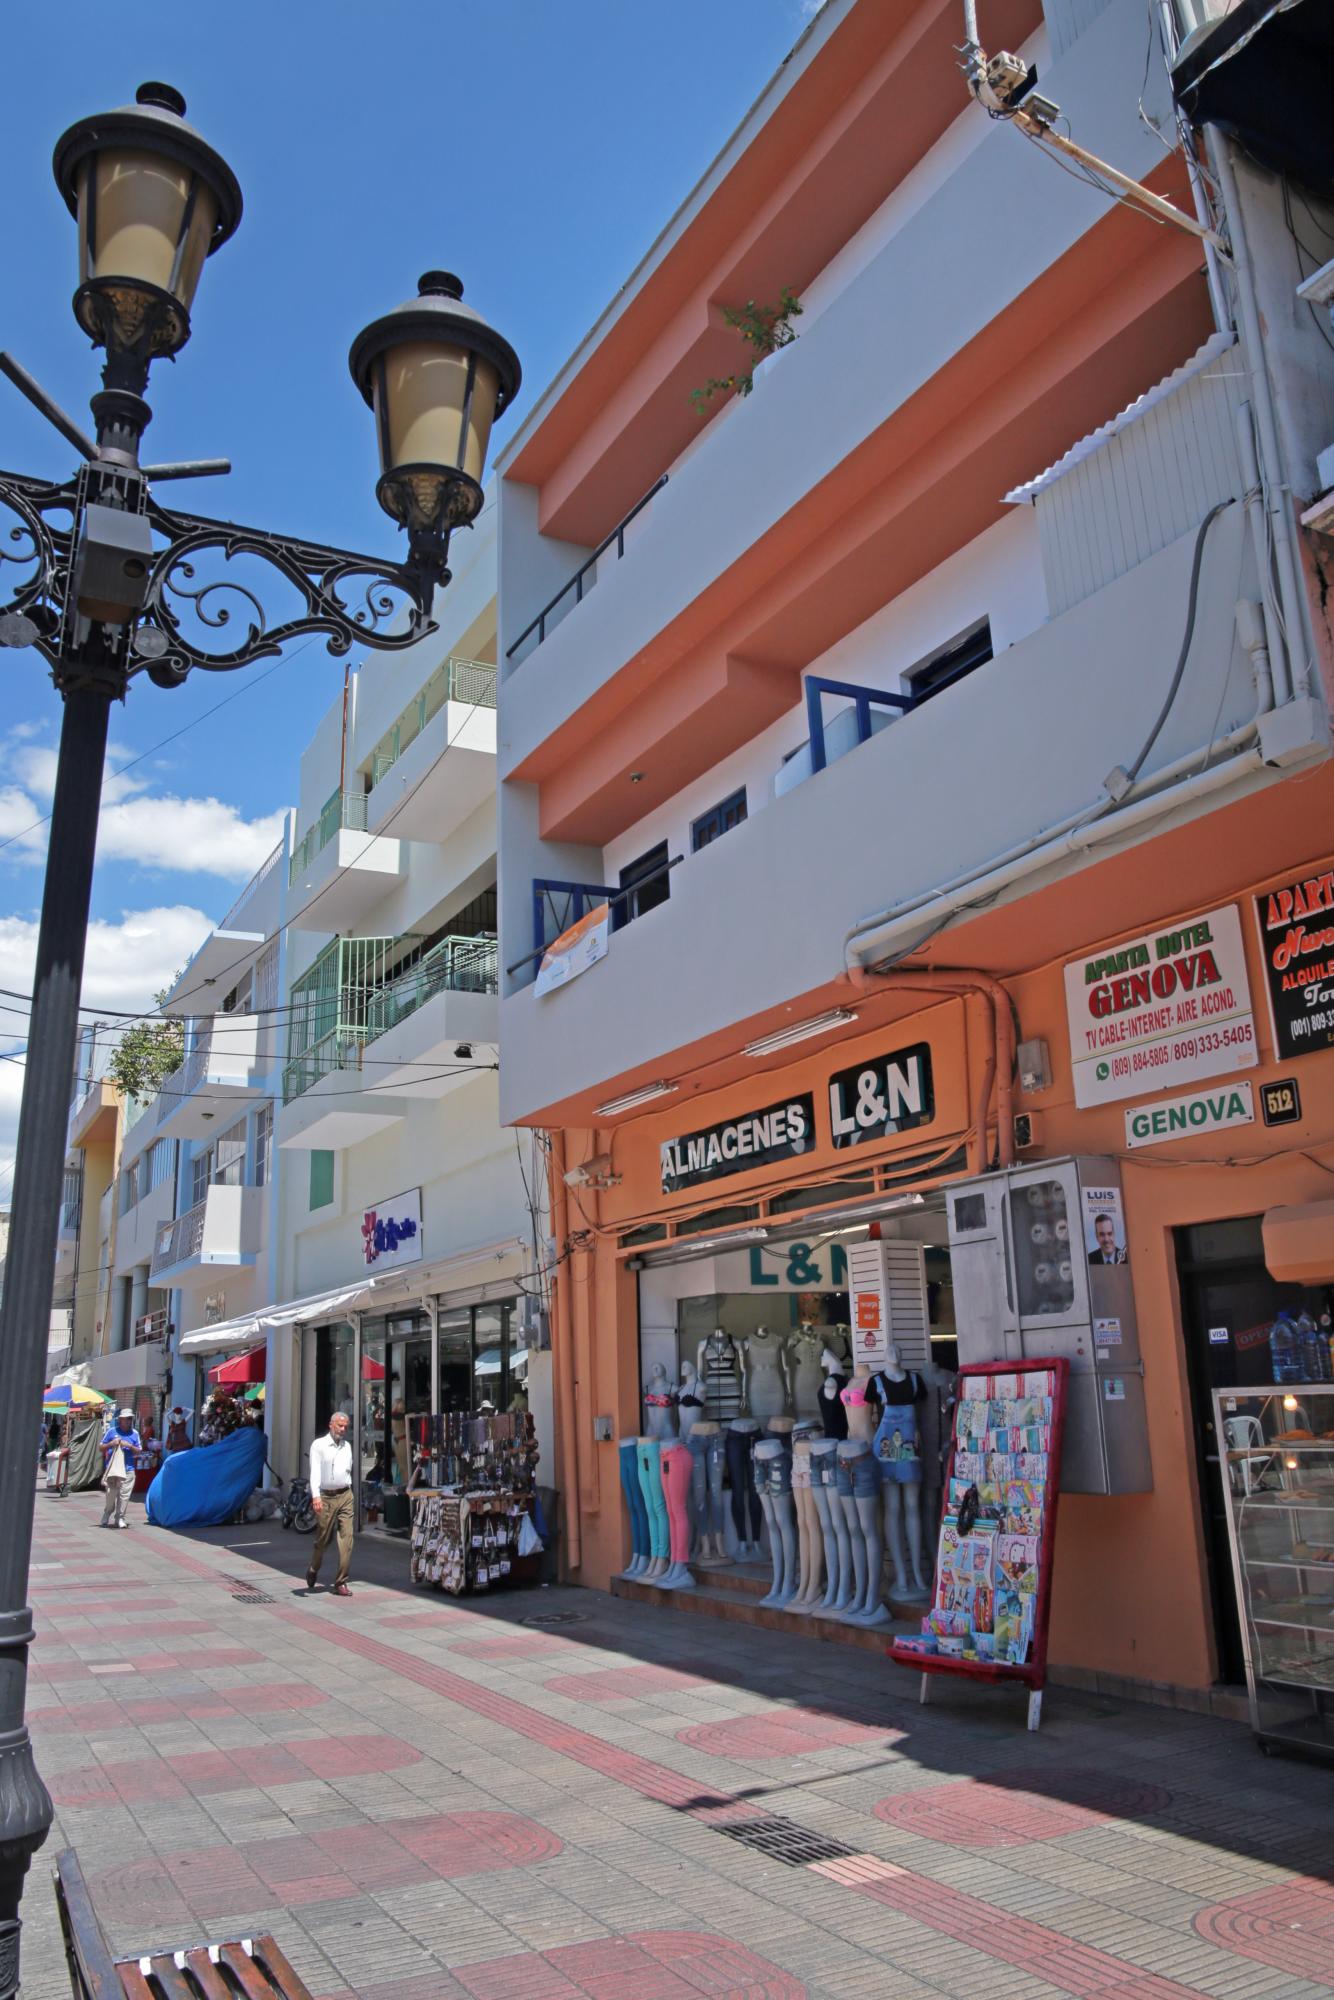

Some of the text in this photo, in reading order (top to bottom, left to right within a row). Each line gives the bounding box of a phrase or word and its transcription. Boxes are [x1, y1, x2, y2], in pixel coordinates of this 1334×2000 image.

[1267, 871, 1334, 930] APART
[1085, 921, 1214, 985] APARTA HOTEL
[1088, 949, 1222, 1020] GENOVA
[1086, 1030, 1097, 1050] TV
[1177, 999, 1198, 1024] AIRE
[1201, 988, 1237, 1016] ACOND.
[1290, 1014, 1311, 1040] (001)
[1111, 1055, 1131, 1080] (809)
[1133, 1045, 1169, 1072] 884-5805
[1199, 1024, 1252, 1053] 333-5405
[661, 1055, 922, 1180] ALMACENES L&N
[1132, 1092, 1247, 1138] GENOVA
[1267, 1088, 1293, 1114] 512
[1212, 1330, 1227, 1339] VISA
